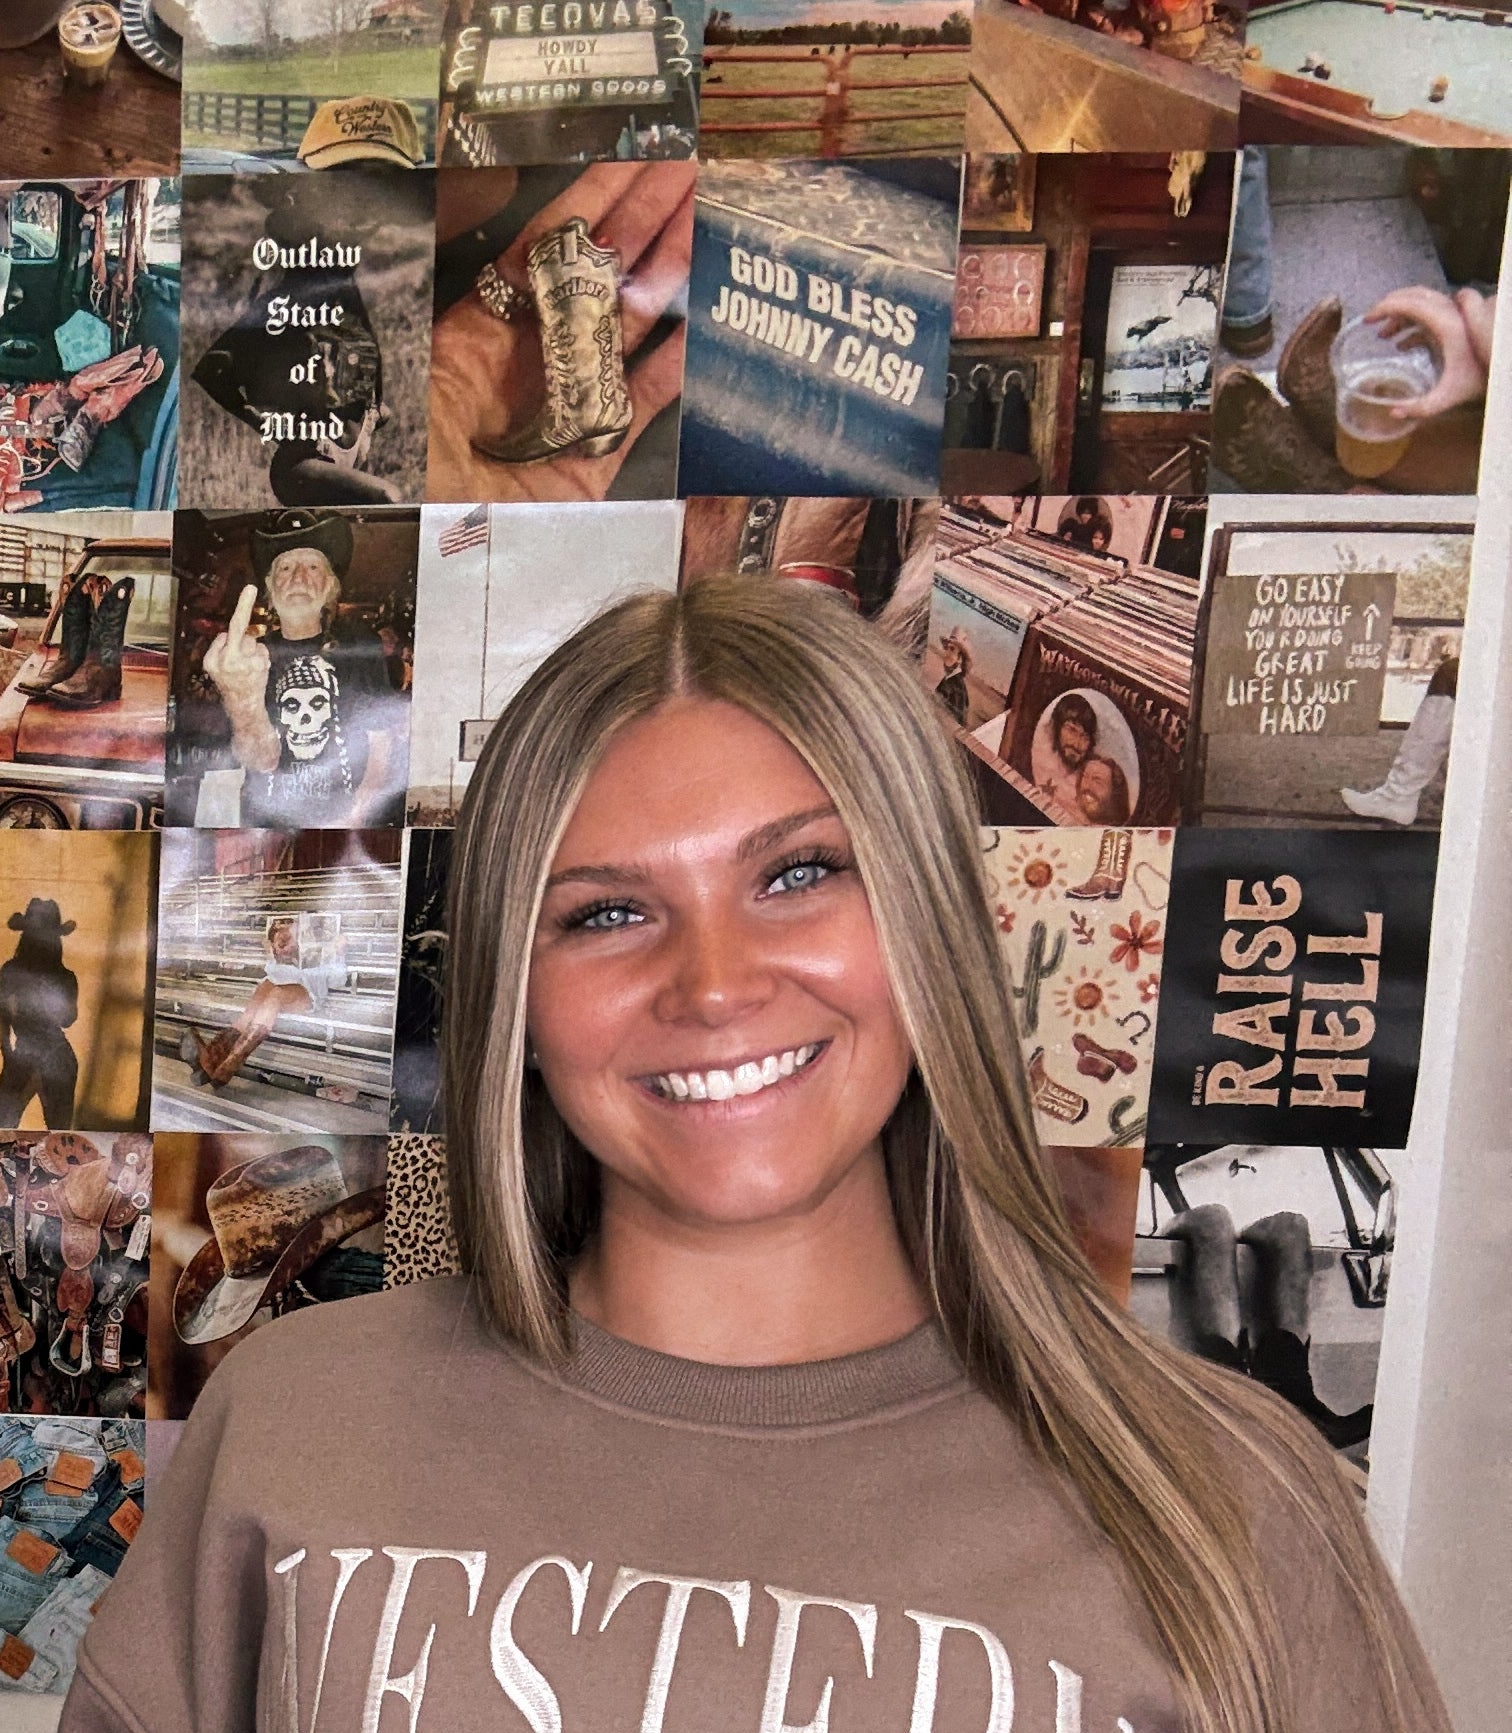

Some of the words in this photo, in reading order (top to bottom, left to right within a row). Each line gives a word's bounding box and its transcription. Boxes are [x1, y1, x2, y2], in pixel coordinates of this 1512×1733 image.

[537, 38, 598, 57] HOWDY
[475, 82, 582, 102] WESTERN
[591, 79, 667, 98] GOODS
[252, 236, 362, 271] Outlaw
[729, 246, 799, 301] GOD
[807, 273, 918, 347] BLESS
[265, 295, 345, 336] State
[711, 285, 834, 363] JOHNNY
[833, 335, 925, 406] CASH
[289, 353, 322, 385] of
[259, 411, 345, 445] Mind
[1255, 574, 1288, 605] GO
[1294, 574, 1346, 604] EASY
[1248, 606, 1274, 628] ON
[1279, 603, 1352, 628] YOURSELF
[1244, 628, 1275, 651] YOU
[1254, 650, 1329, 678] GREAT
[1226, 675, 1275, 707] LIFE
[1281, 678, 1304, 705] IS
[1307, 679, 1358, 705] JUST
[1259, 704, 1326, 736] HARD
[1205, 874, 1302, 1108] RAISE
[1290, 911, 1384, 1109] HELL
